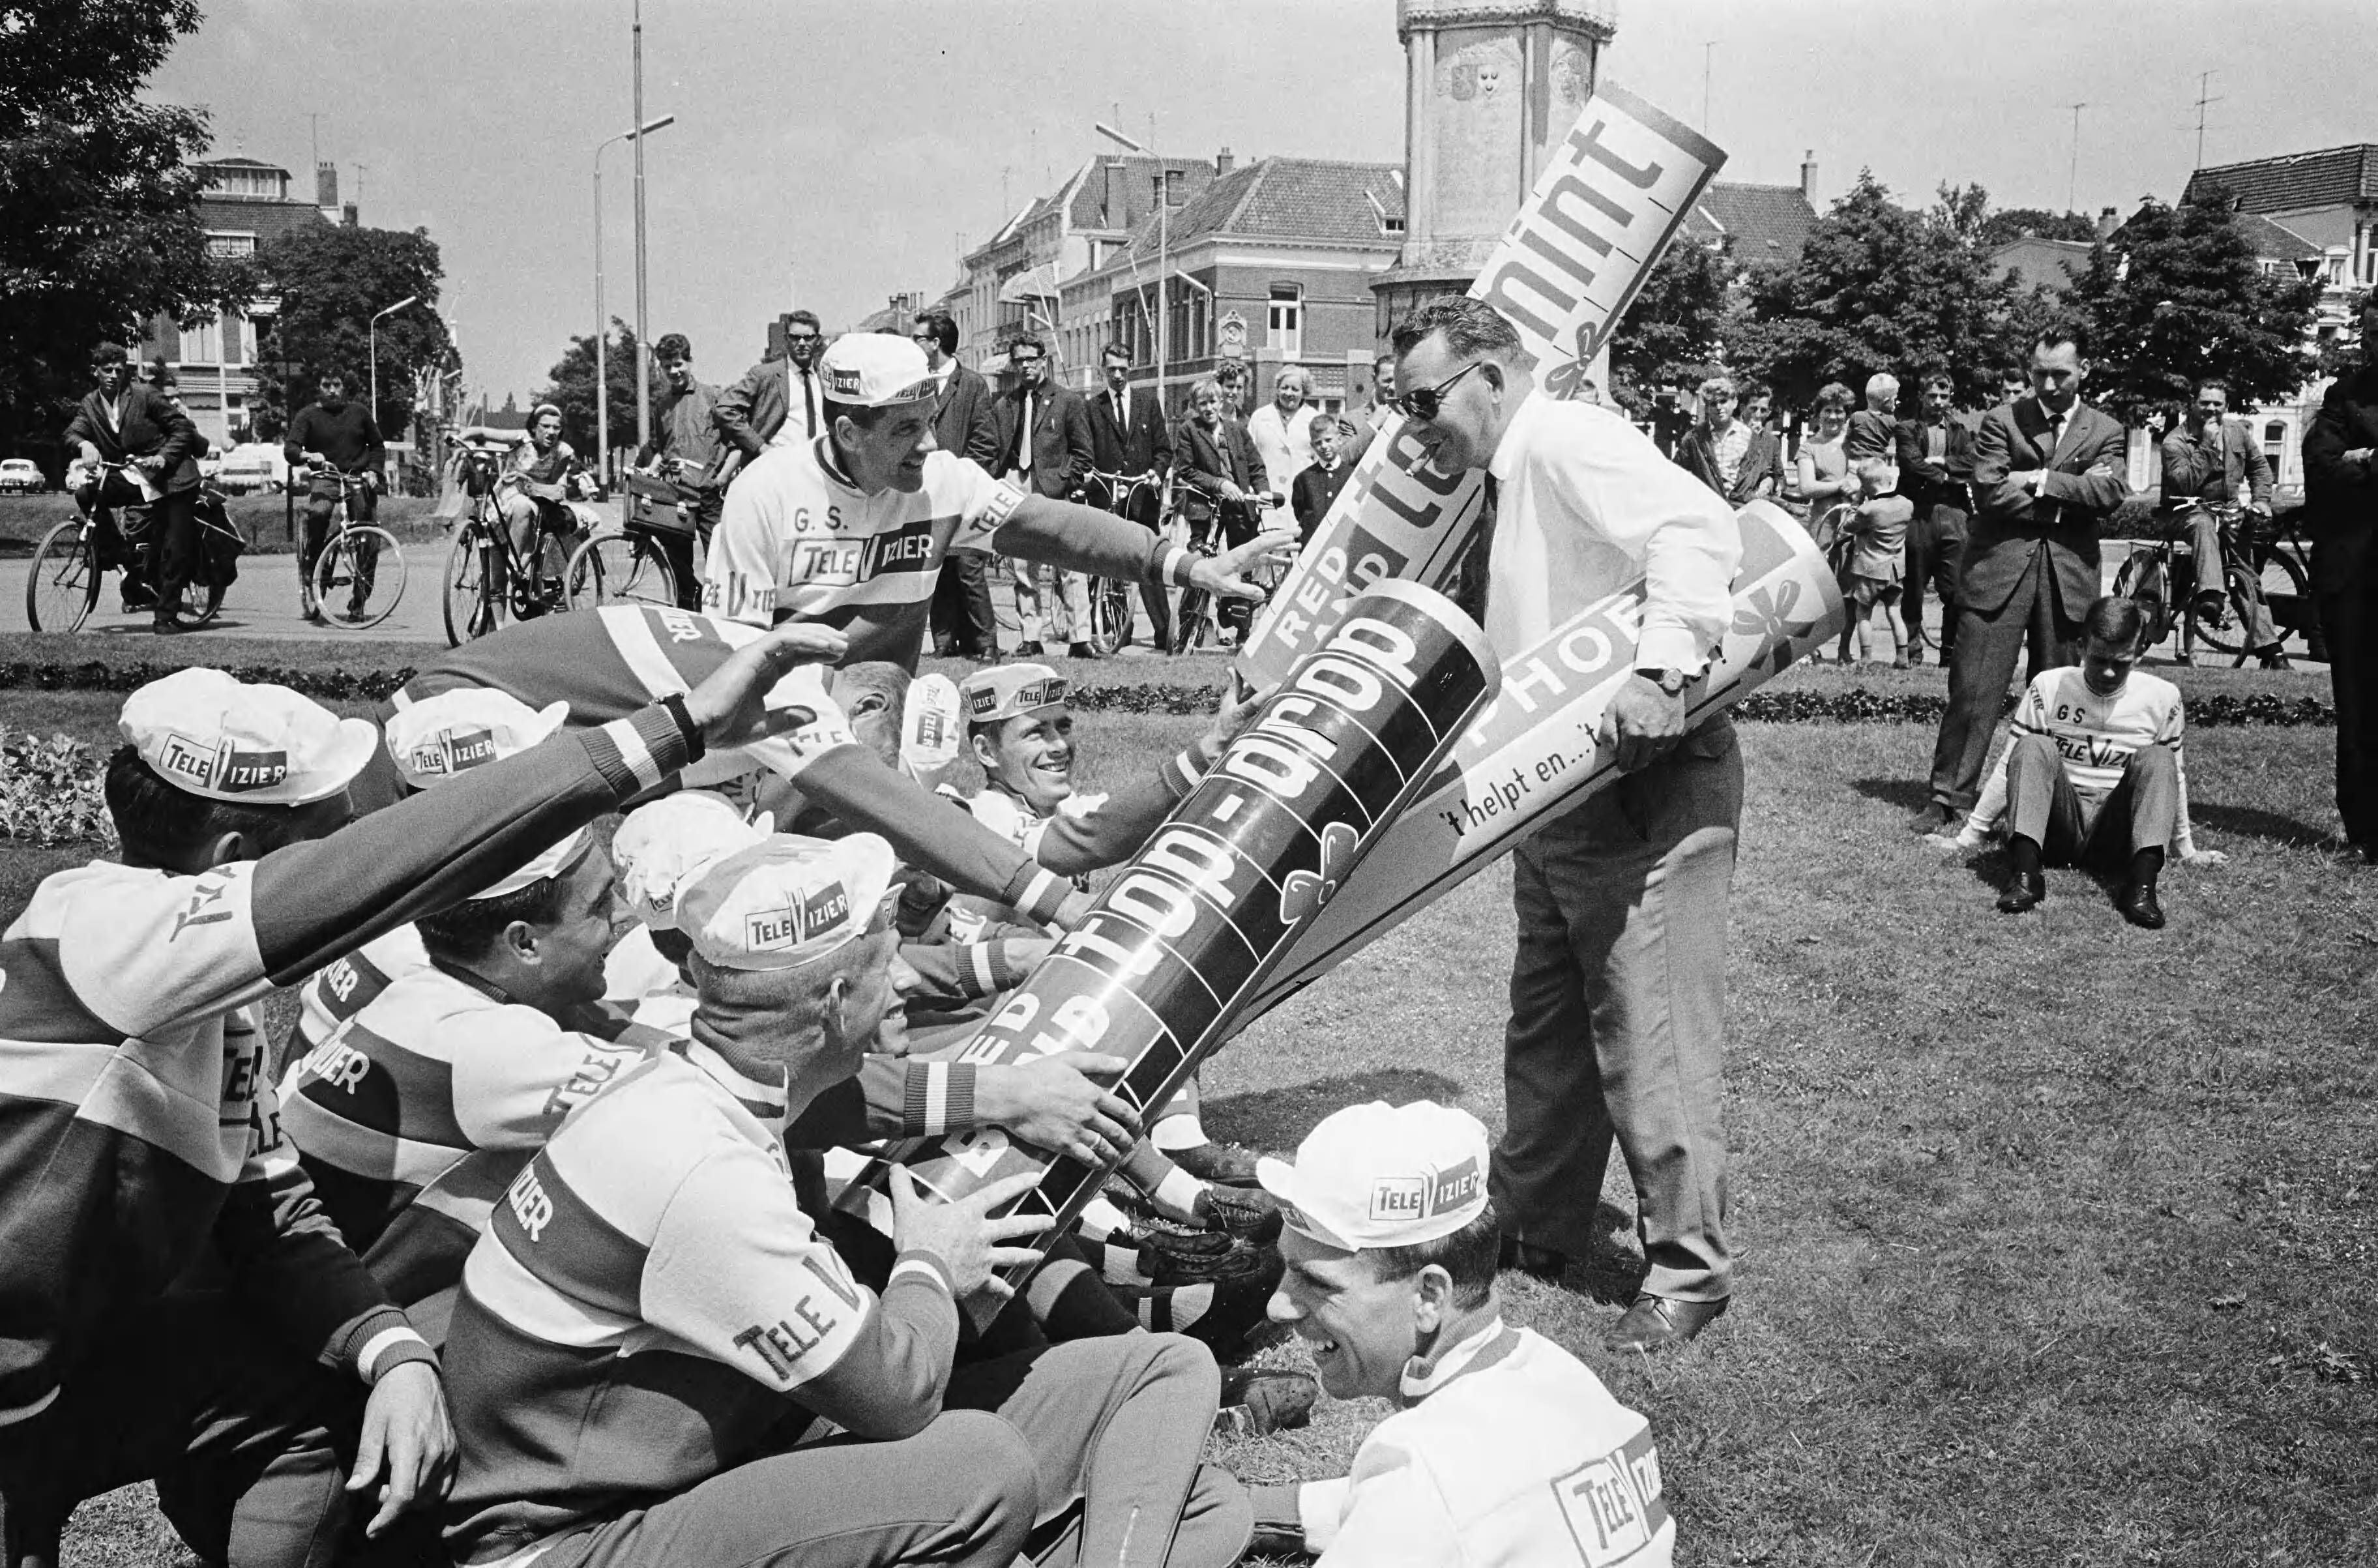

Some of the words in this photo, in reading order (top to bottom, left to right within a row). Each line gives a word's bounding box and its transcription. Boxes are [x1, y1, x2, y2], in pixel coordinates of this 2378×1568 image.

[1275, 546, 1347, 648] RED
[1060, 617, 1420, 976] top-drop
[1460, 768, 1531, 828] helpt
[956, 993, 1040, 1066] ED
